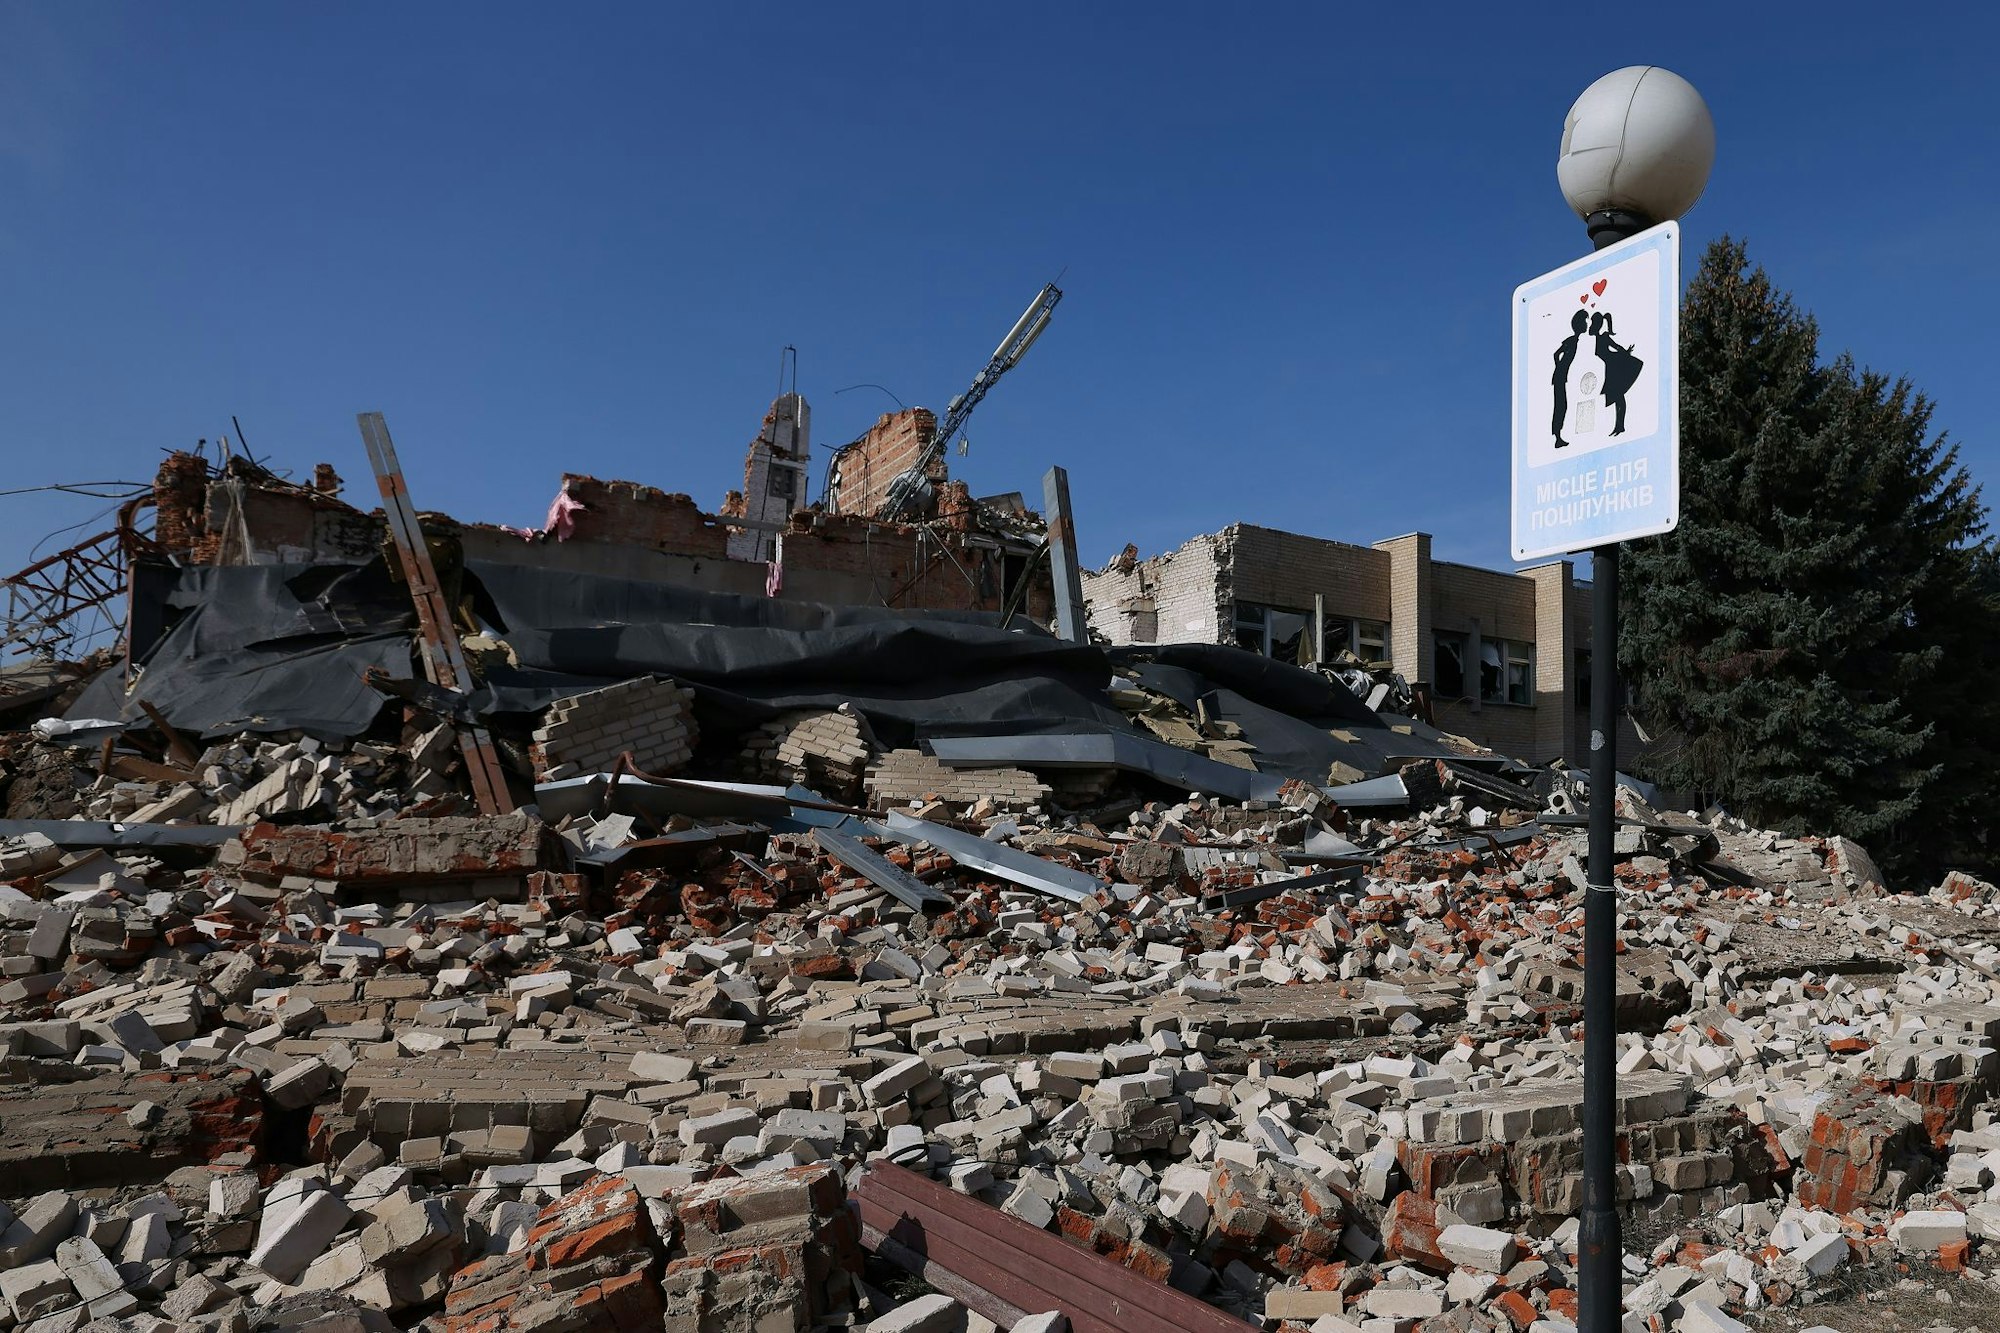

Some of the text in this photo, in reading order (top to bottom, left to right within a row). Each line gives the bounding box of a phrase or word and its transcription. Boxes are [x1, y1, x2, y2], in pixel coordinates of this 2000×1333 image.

[1536, 457, 1648, 504] МІСЦЕ ДЛЯ
[1530, 484, 1654, 531] ПОЦІЛУНКІВ
